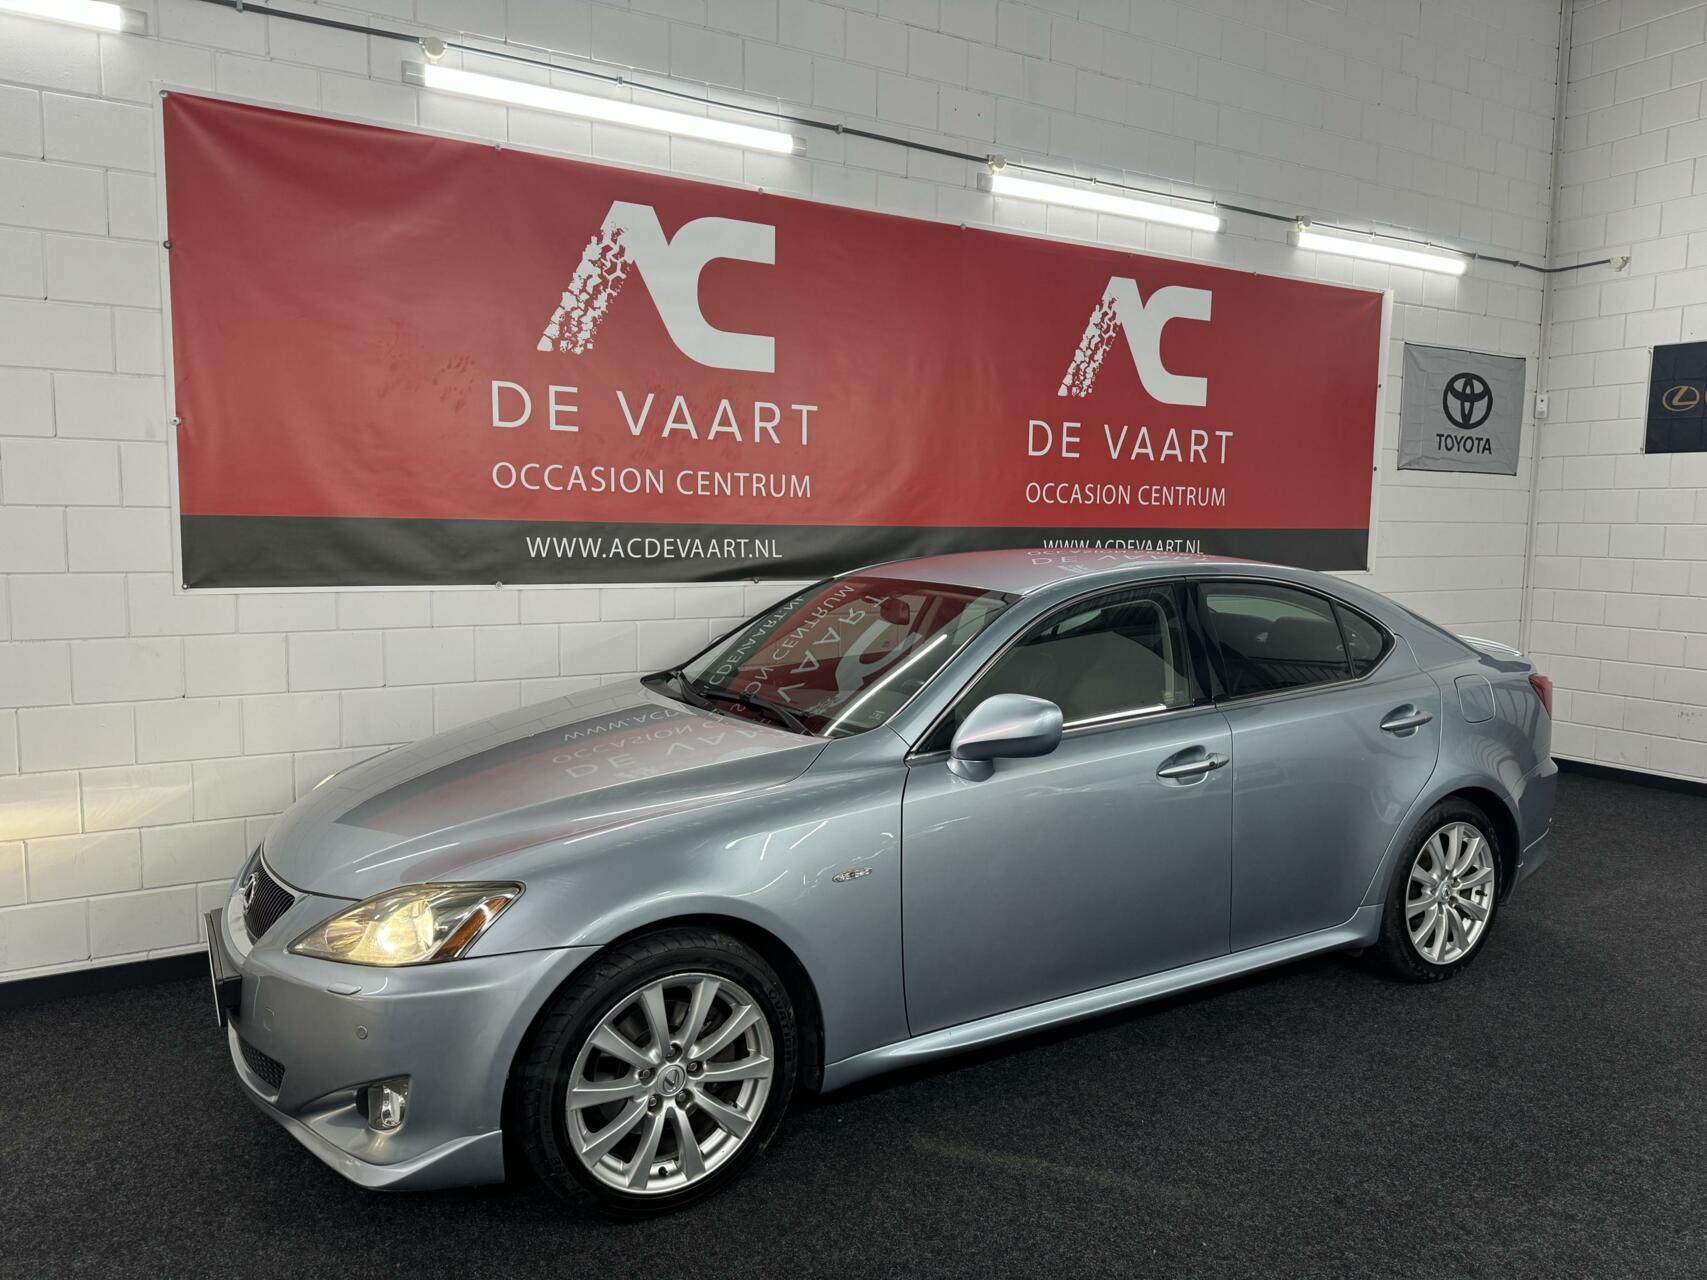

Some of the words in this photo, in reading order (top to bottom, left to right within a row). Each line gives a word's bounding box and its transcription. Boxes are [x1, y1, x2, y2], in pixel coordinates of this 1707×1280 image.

[537, 200, 775, 373] AC
[1057, 276, 1213, 407] AC
[491, 380, 580, 432] DE
[616, 390, 818, 445] VAART
[1027, 419, 1081, 458] DE
[1104, 424, 1233, 464] VAART
[1436, 433, 1492, 455] TOYOTA
[492, 462, 664, 494] OCCASION
[676, 470, 811, 498] CENTRUM
[1026, 482, 1131, 505] OCCASION
[1138, 485, 1225, 506] CENTRUM
[526, 537, 782, 558] WWW.ACDEVAART.NL
[1043, 539, 1204, 554] WWWACDEVAARTNL
